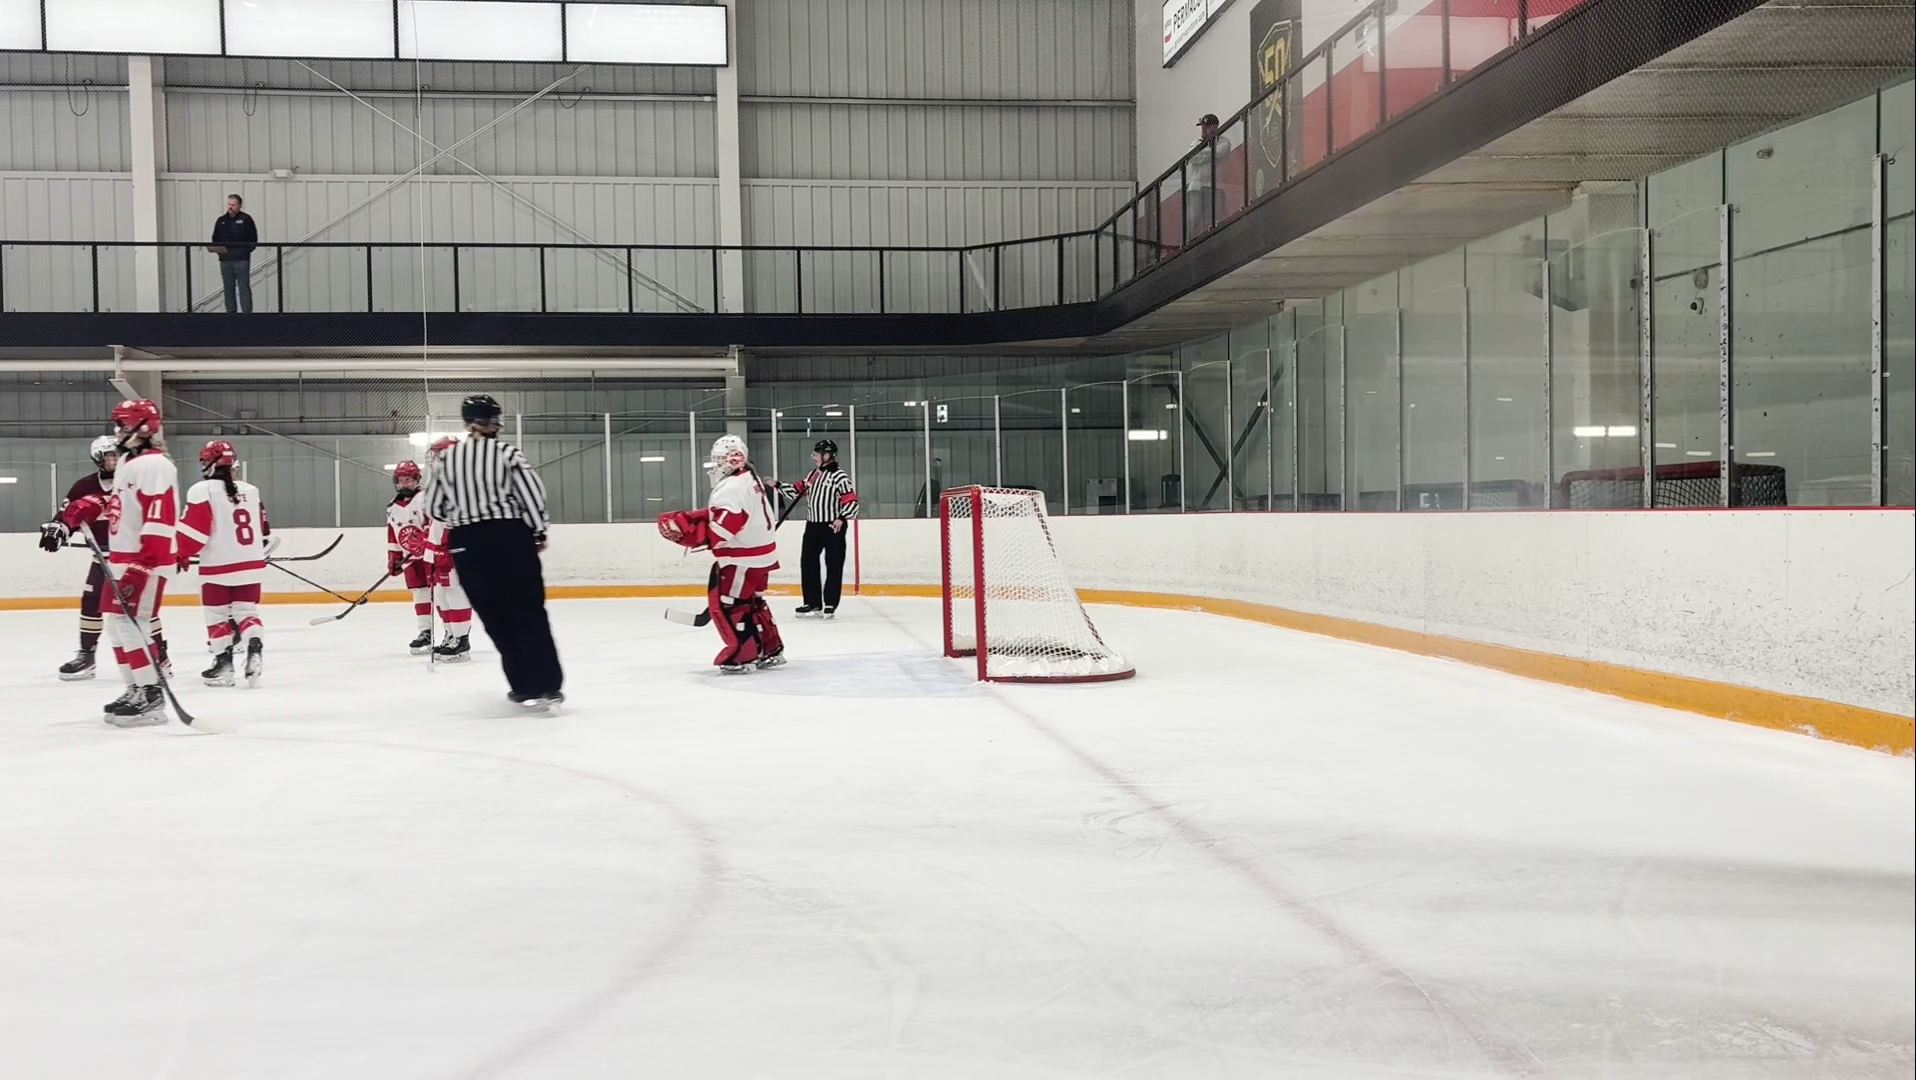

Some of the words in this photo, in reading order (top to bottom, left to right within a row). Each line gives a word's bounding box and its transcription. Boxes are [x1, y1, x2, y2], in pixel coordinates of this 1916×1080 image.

[1173, 0, 1205, 33] PERMAC
[147, 499, 163, 519] 11
[233, 508, 254, 546] 8
